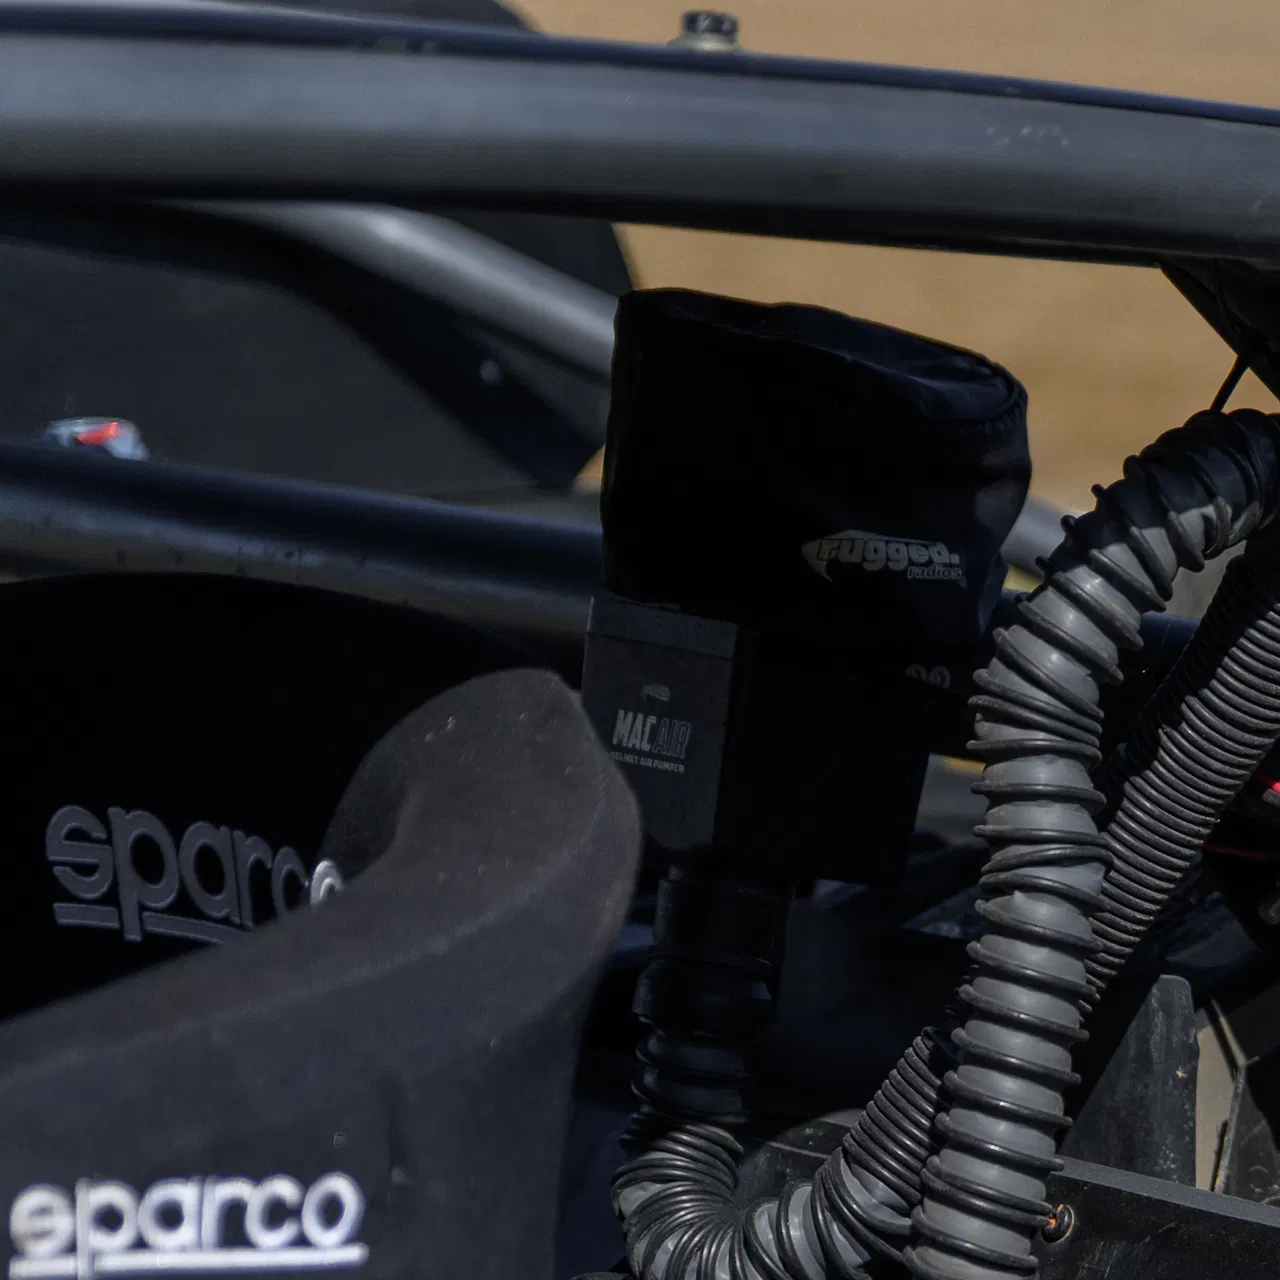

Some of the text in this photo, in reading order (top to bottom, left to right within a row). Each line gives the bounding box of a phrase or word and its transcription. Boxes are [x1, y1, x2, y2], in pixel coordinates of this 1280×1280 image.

[906, 564, 963, 581] radios
[612, 708, 692, 759] MAC AIR
